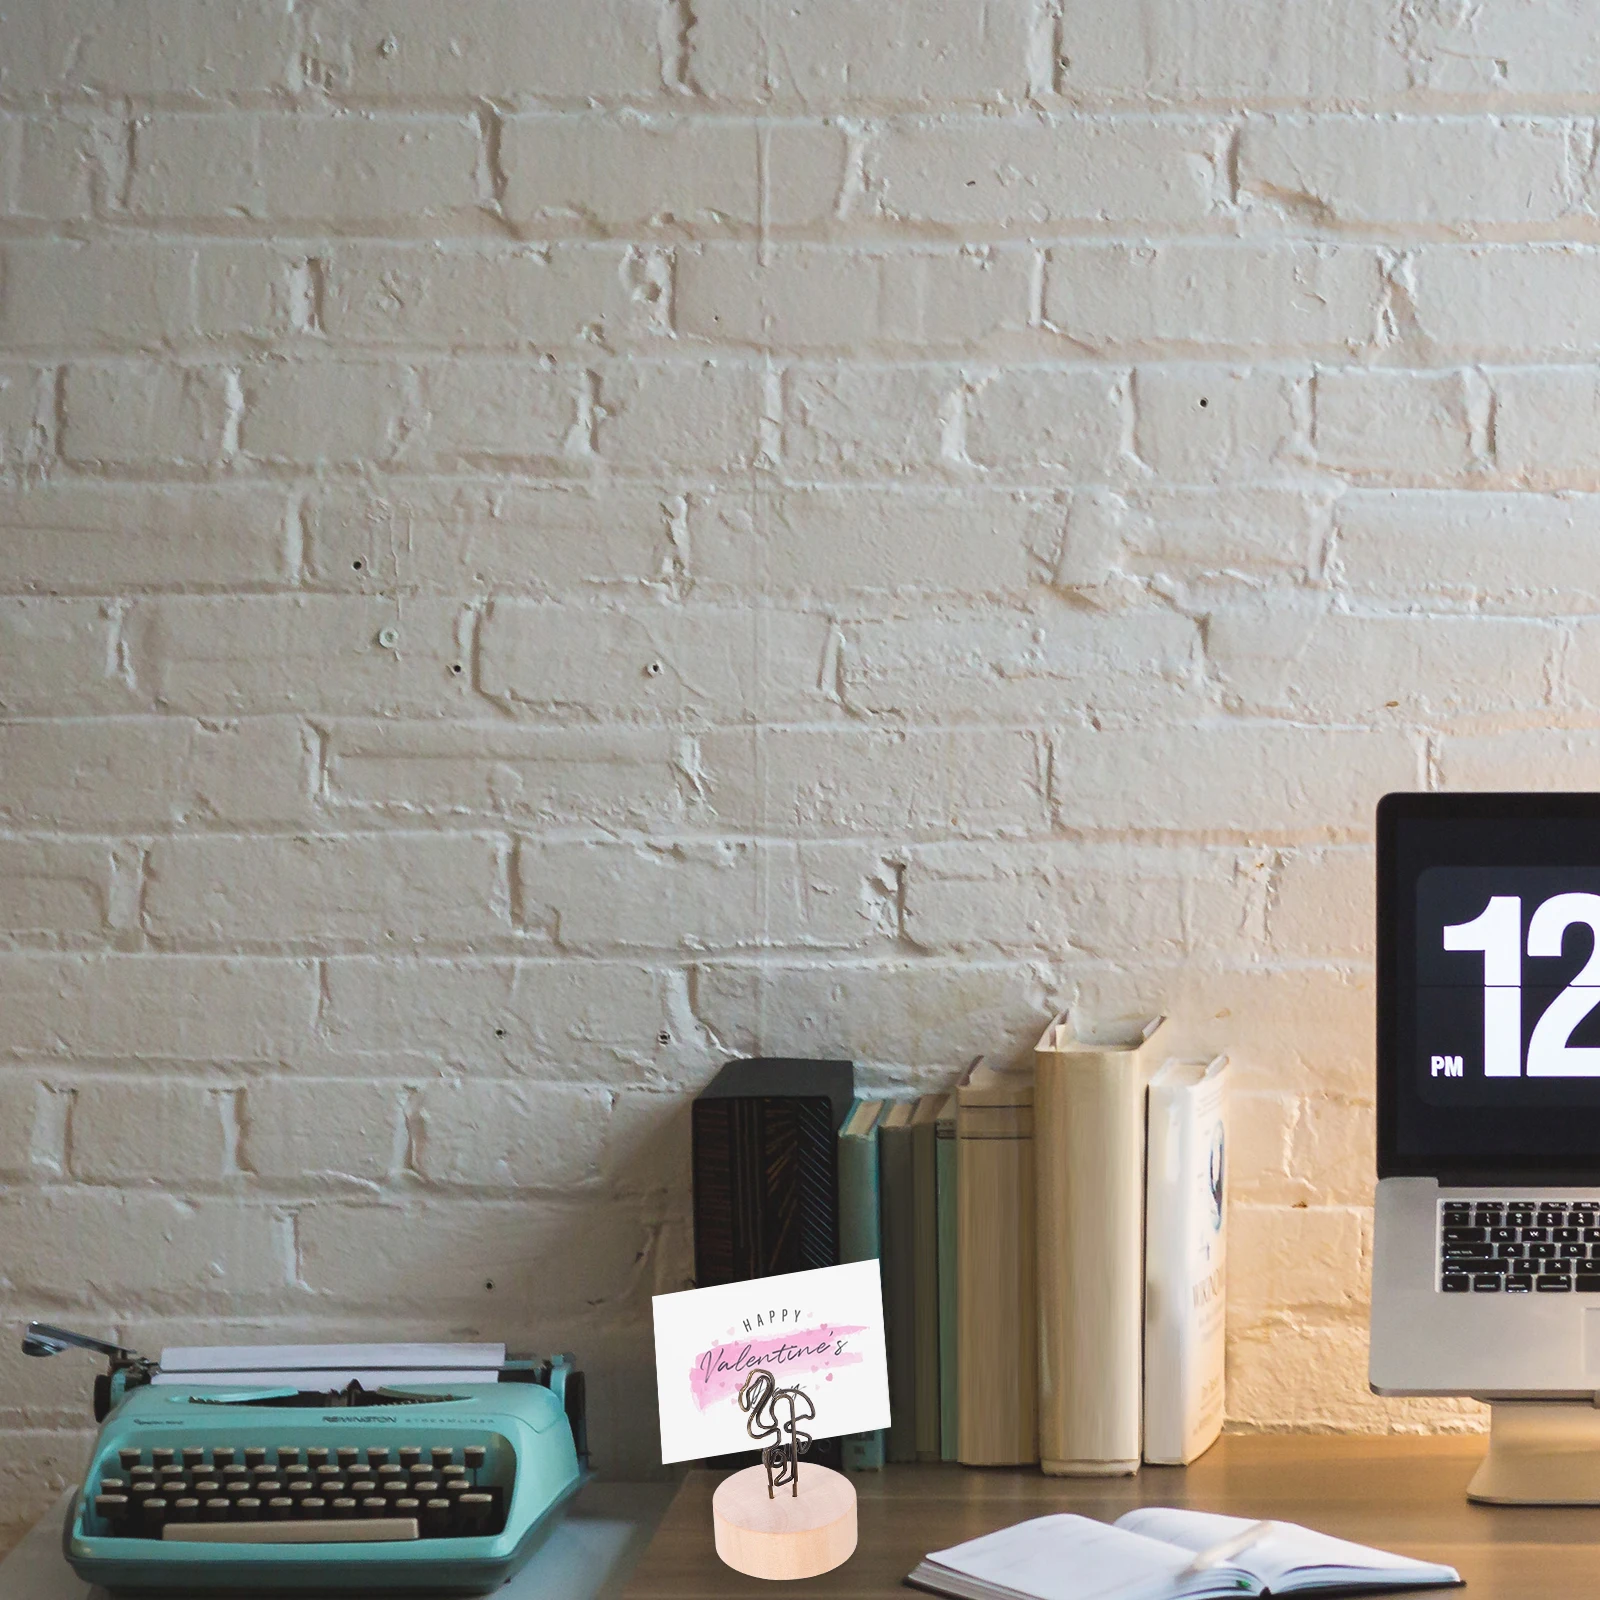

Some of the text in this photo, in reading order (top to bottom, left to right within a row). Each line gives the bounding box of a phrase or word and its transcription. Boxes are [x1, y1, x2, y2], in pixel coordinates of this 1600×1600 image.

[1443, 892, 1600, 1077] 12
[1431, 1056, 1463, 1077] PM
[1499, 1230, 1508, 1238] Q
[743, 1309, 801, 1332] HAPPY
[700, 1331, 848, 1383] Valentine's
[322, 1415, 397, 1424] REMINGTON
